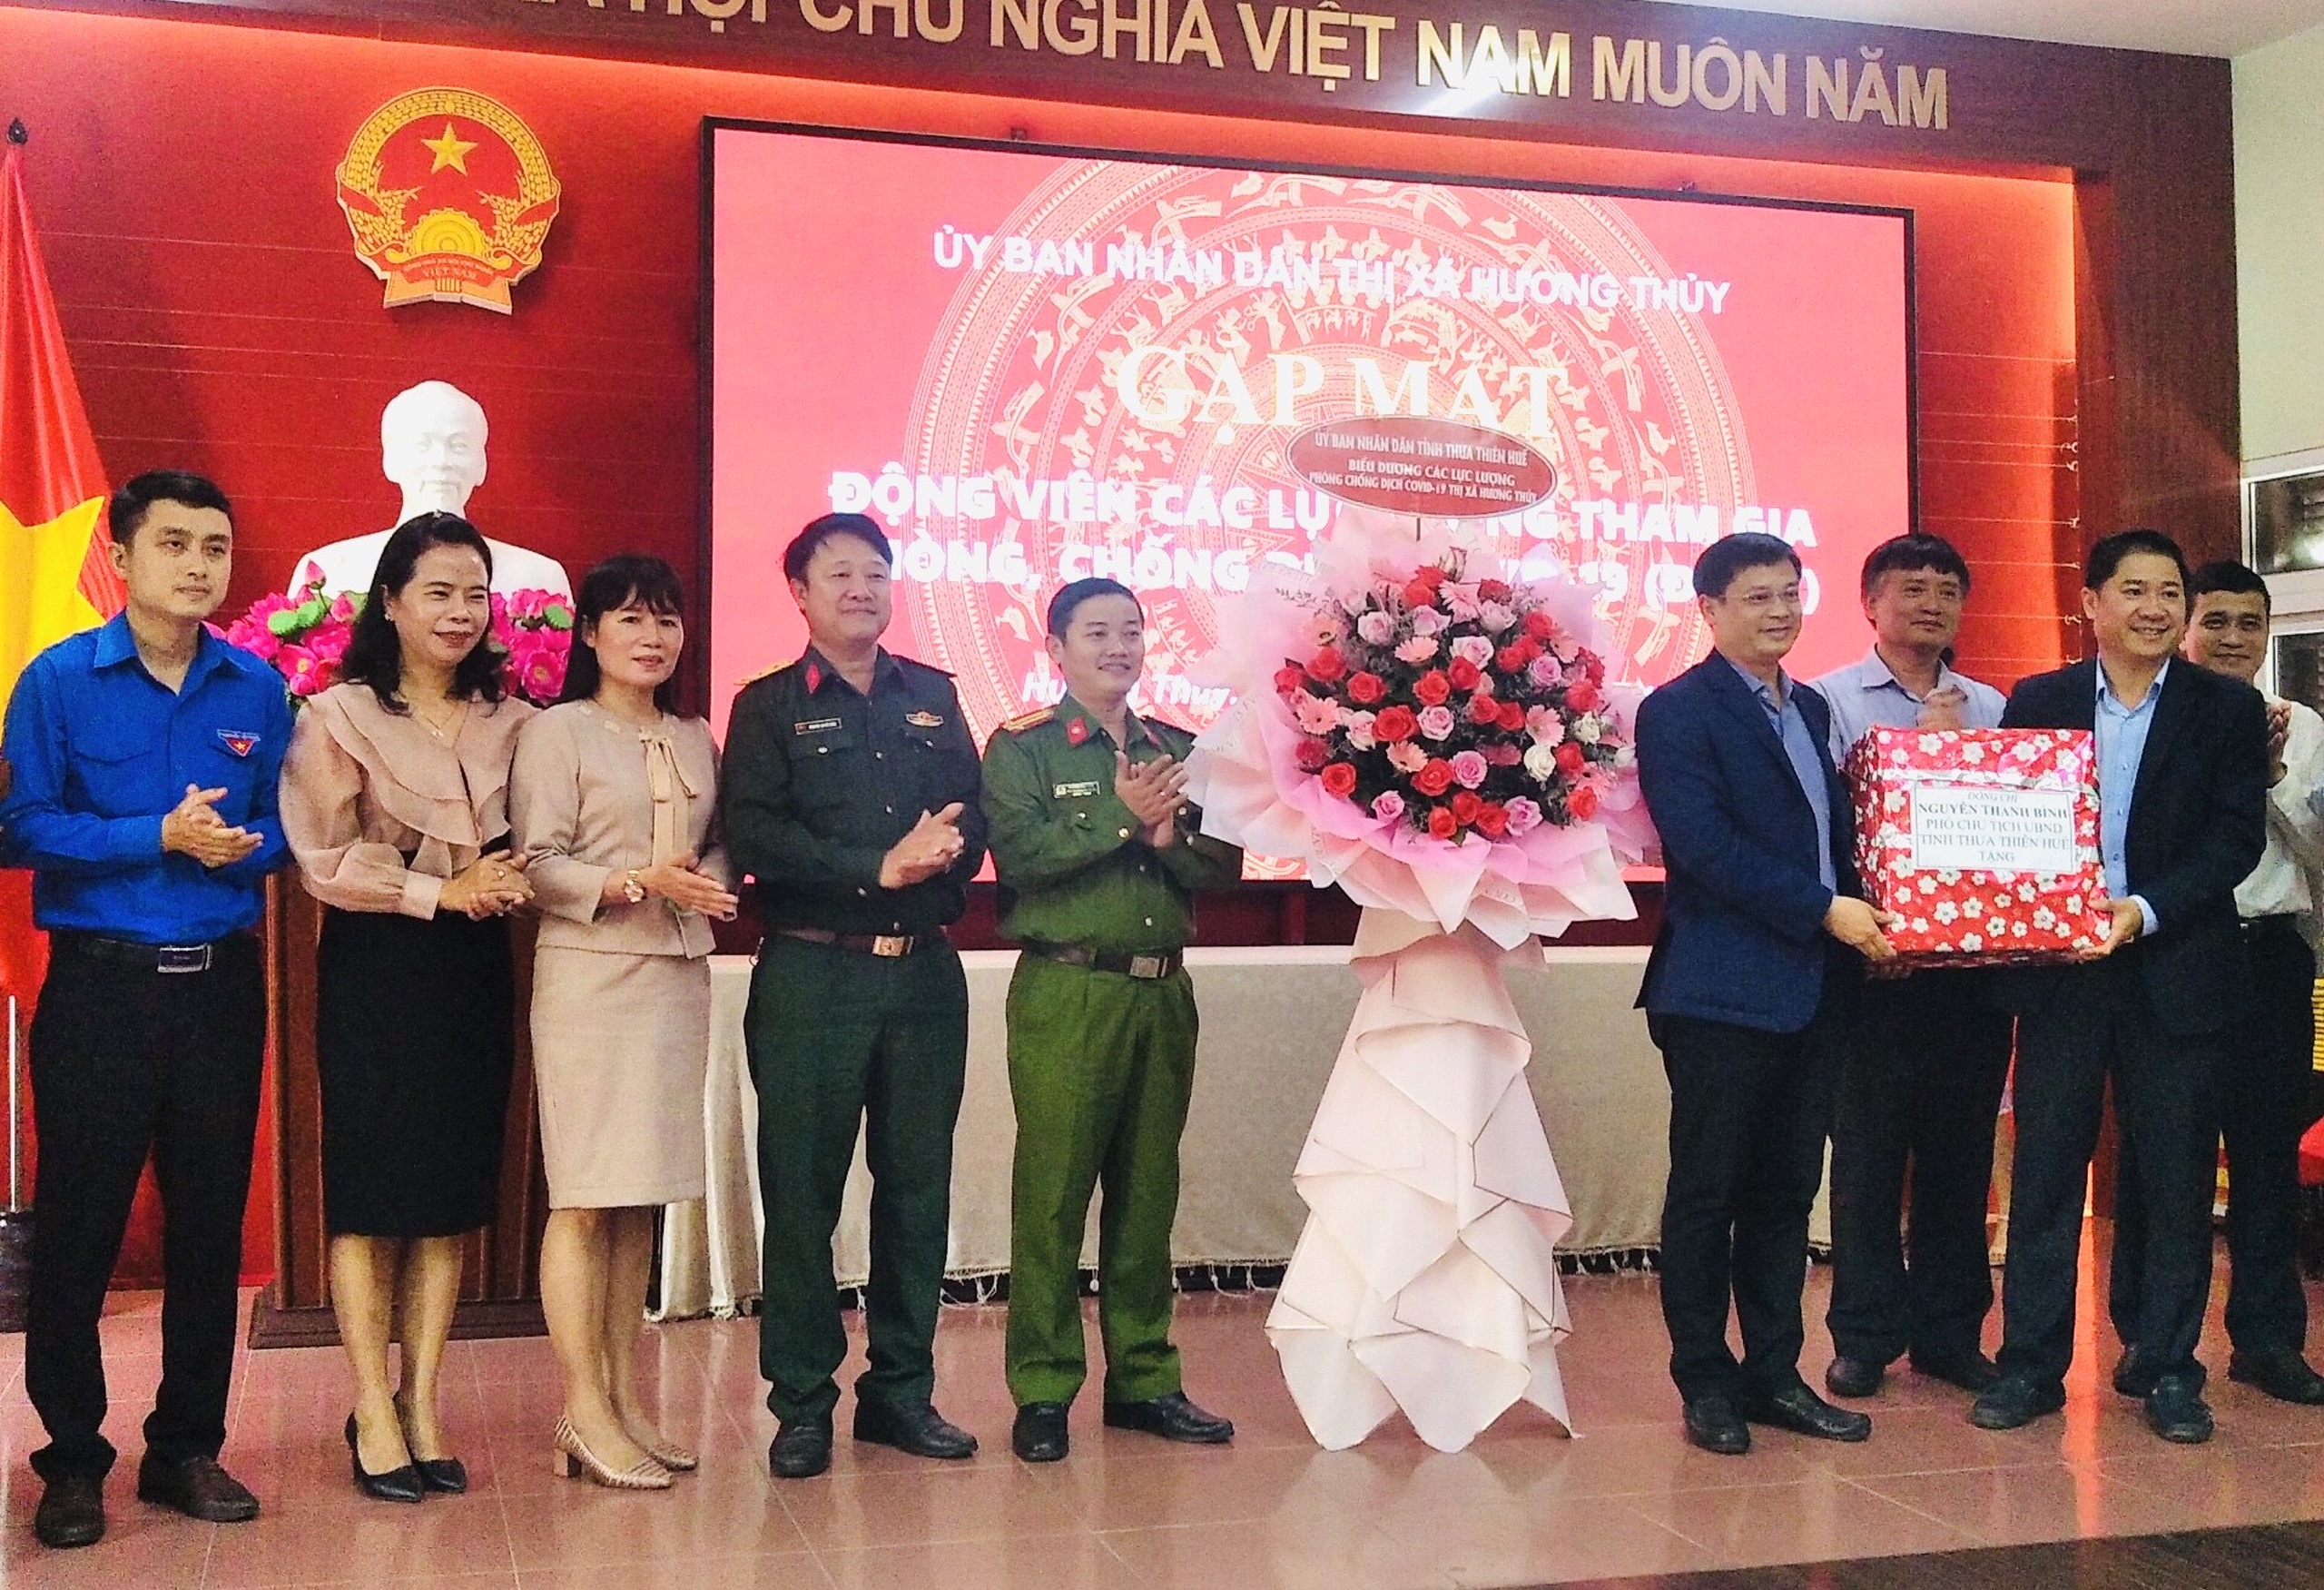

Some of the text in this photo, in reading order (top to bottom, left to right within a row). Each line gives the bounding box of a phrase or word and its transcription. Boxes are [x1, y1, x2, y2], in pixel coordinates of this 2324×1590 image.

[1237, 0, 1395, 93] VIỆT
[1416, 20, 1571, 98] NAM
[1591, 35, 1787, 116] MUÔN
[1804, 44, 1948, 131] NĂM
[933, 224, 994, 271] ỦY
[1003, 237, 1094, 277] BAN
[1106, 240, 1224, 285] NHÂN
[1235, 246, 1321, 292] DÂN
[1471, 267, 1621, 309] HƯƠNG
[1630, 272, 1731, 315] THỦY
[1332, 434, 1355, 449] BAN
[1378, 460, 1423, 477] DƯƠNG
[1424, 464, 1449, 479] CÁC
[1452, 468, 1473, 484] LỰC
[1475, 471, 1516, 488] LƯỢNG
[1381, 478, 1403, 491] DỊCH
[1404, 479, 1447, 495] COVID-19
[828, 460, 997, 527] ĐỘNG
[1012, 468, 1137, 524] VIÊN
[1151, 475, 1254, 530] CÁC
[1571, 500, 1721, 547] THAM
[1733, 506, 1818, 548] GIA
[1058, 532, 1250, 590] CHỐNG
[1980, 805, 2030, 817] THANH
[2024, 821, 2063, 835] UBND
